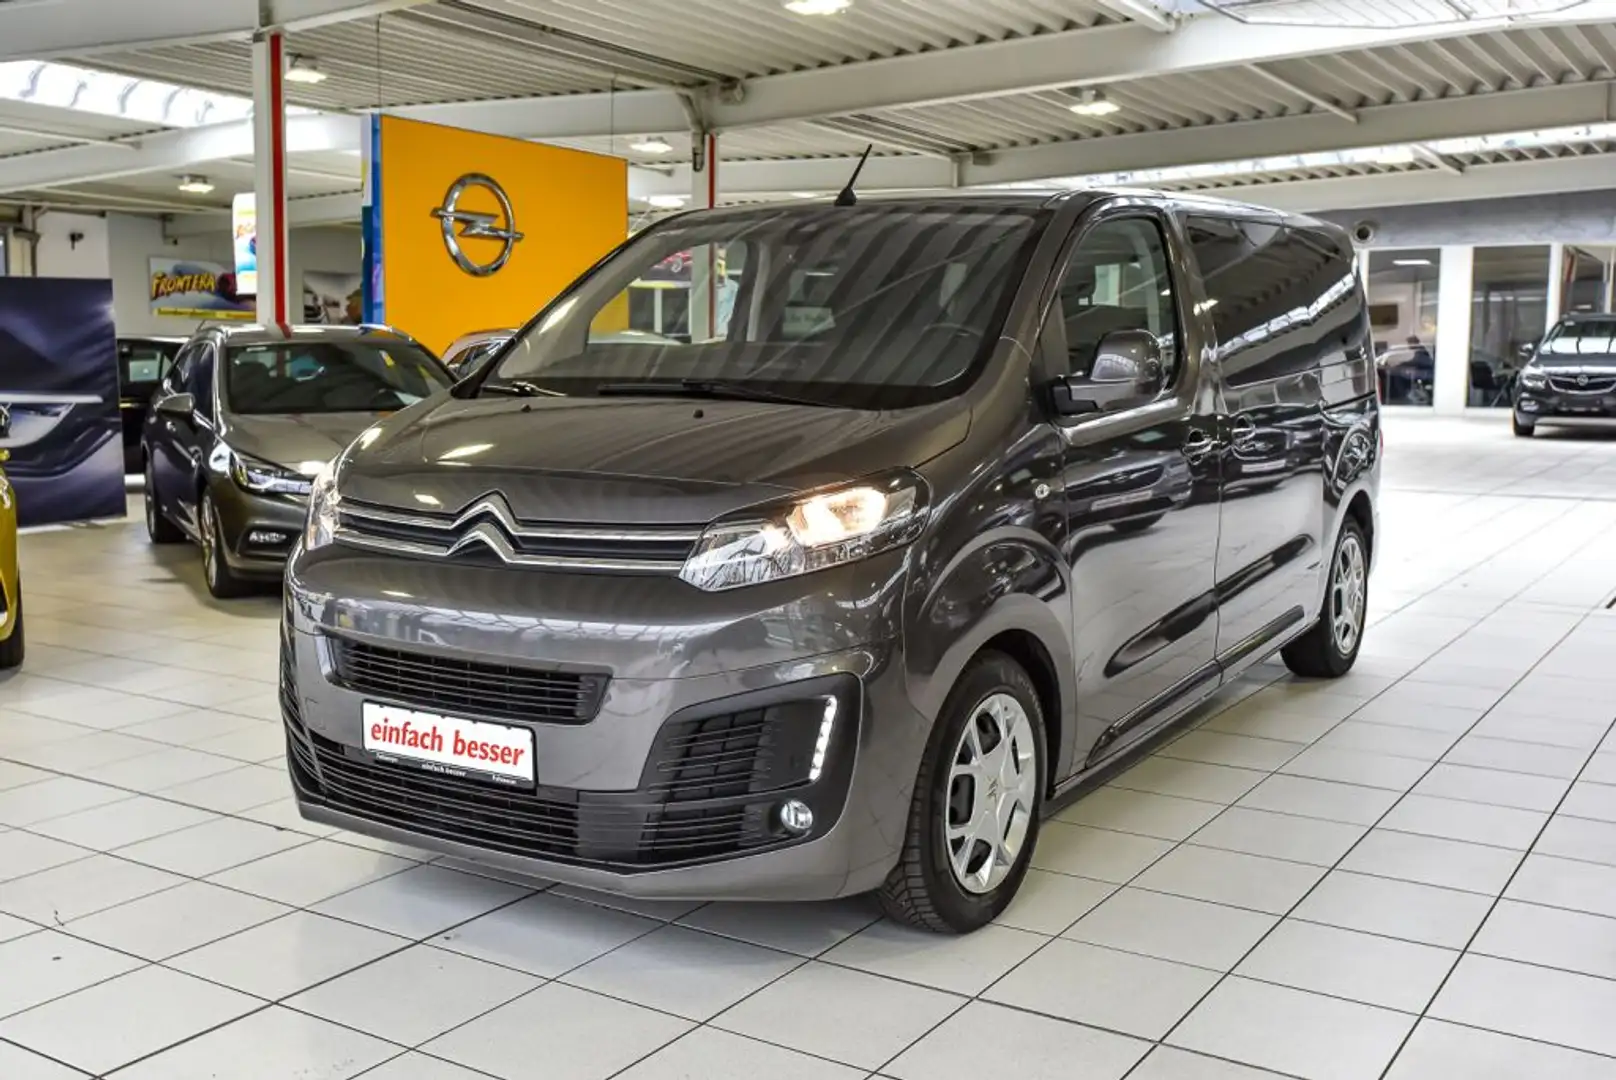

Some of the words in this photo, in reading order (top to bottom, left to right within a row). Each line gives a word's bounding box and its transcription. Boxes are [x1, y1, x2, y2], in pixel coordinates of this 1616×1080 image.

[152, 272, 216, 299] FRONTERA
[371, 719, 443, 752] einfach
[453, 730, 525, 765] besser
